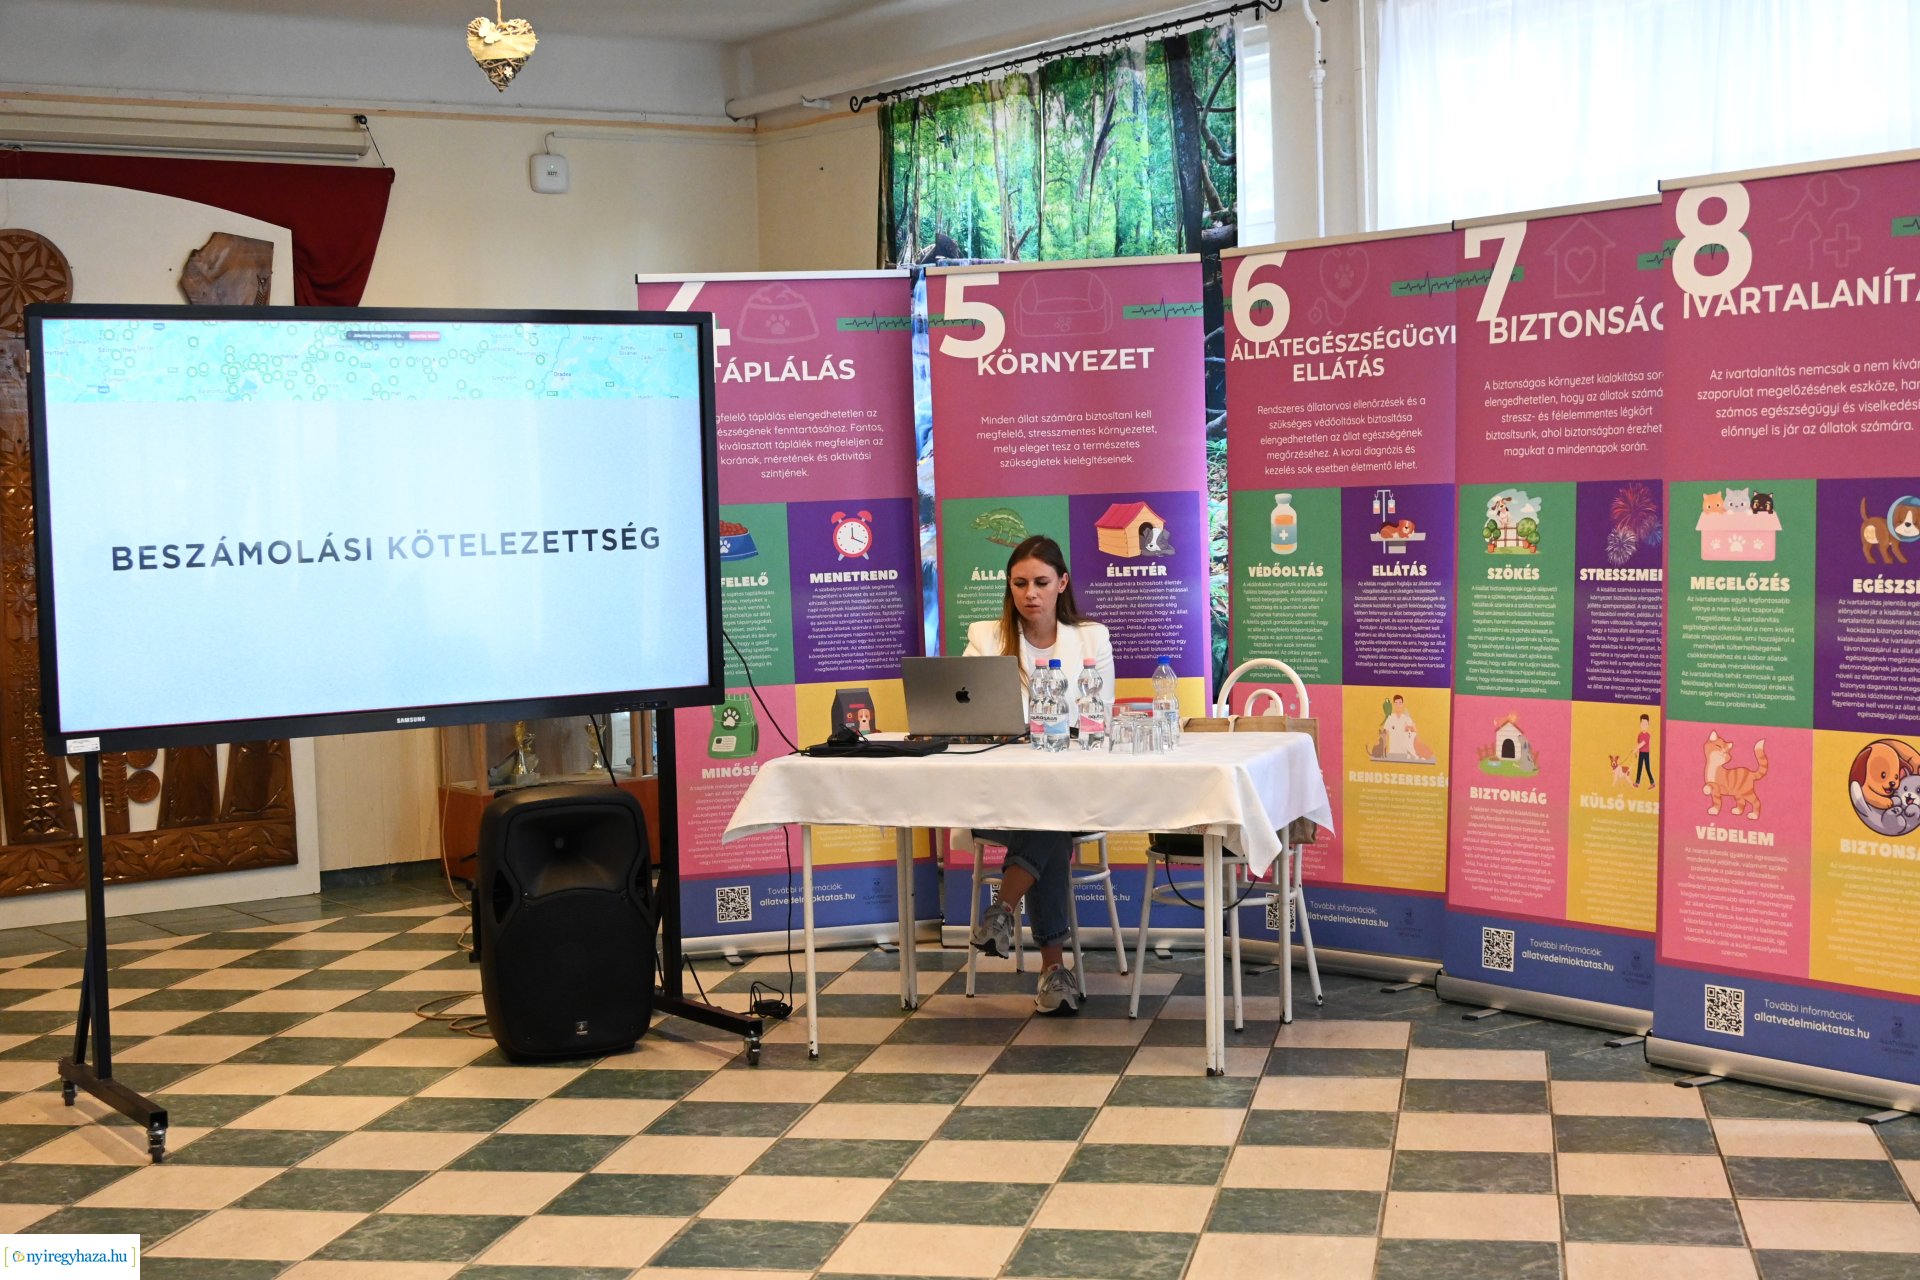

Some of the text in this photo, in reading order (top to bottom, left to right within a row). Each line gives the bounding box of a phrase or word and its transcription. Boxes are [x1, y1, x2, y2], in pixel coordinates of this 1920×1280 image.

[1672, 182, 1752, 297] 8
[1464, 220, 1527, 322] 7
[1231, 251, 1291, 344] 6
[1683, 267, 1920, 320] IVARTALANÍT
[939, 272, 1006, 359] 5
[1230, 324, 1457, 361] ÁLLATEGÉSZSÉGÜGYI
[715, 354, 856, 383] ÁPLÁLÁS
[977, 347, 1155, 376] KÖRNYEZET
[1293, 355, 1385, 382] ELLÁTÁS
[1709, 369, 1723, 380] Az
[1725, 365, 1796, 379] ivartalanítás
[1798, 361, 1850, 375] nemcsak
[1852, 363, 1861, 373] a
[1863, 361, 1889, 372] nem
[1484, 371, 1664, 390] A biztonságos környezet kialakítása sor
[1484, 393, 1558, 408] elengedhetetlen,
[1560, 392, 1584, 405] hogy
[1586, 393, 1597, 402] az
[1599, 388, 1629, 401] állatok
[1697, 386, 1754, 402] szaporulat
[1756, 381, 1847, 399] megelőzésének
[1849, 379, 1898, 393] eszköze,
[1257, 396, 1426, 415] Rendszeres állatorvosi ellenőrzések és a
[1501, 405, 1653, 423] stressz- és félelemmentes légkört
[1715, 406, 1758, 418] számos
[1760, 402, 1840, 419] egészségügyi
[1842, 401, 1855, 413] és
[748, 411, 786, 423] táplálás
[788, 409, 864, 421] elengedhetetlen
[980, 409, 1152, 424] Minden állat számára biztosítani kell
[1268, 412, 1413, 430] szükséges védőoltások biztosítása
[774, 423, 848, 435] fenntartásához.
[850, 423, 884, 432] Fontos,
[976, 424, 1157, 441] megfelelő, stresszmentes környezetet,
[1260, 427, 1422, 446] elengedhetetlen az állat egészségének
[1485, 428, 1539, 441] biztosítsunk,
[1540, 427, 1562, 438] ahol
[1564, 424, 1625, 438] biztonságban
[1720, 419, 1914, 439] előnnyel is jár az állatok számára.
[719, 437, 883, 451] kiválasztott táplálék megfeleljen az
[993, 440, 1140, 455] mely eleget tesz a természetes
[1266, 444, 1415, 461] megőrzéséhez. A korai diagnózis és
[1503, 441, 1648, 458] magukat a mindennapok során.
[720, 451, 871, 465] korának, méretének és aktivitási
[999, 453, 1134, 468] szükségletek kielégítéseinek.
[1264, 459, 1417, 475] kezelés sok esetben életmentő lehet.
[760, 467, 809, 479] szintjének.
[112, 523, 662, 572] BESZÁMOLÁSI KÖTELEZETTSÉG
[809, 570, 899, 584] MENETREND
[1106, 561, 1168, 577] ÉLETTÉR
[1248, 562, 1324, 578] VÉDŐOLTÁS
[1372, 561, 1428, 577] ELLÁTÁS
[1487, 564, 1540, 580] SZÖKÉS
[1690, 572, 1790, 592] MEGELŐZÉS
[396, 716, 426, 724] SAMSUNG
[1470, 786, 1547, 805] BIZTONSÁG
[1580, 793, 1660, 814] KÜLSŐ VESZ
[1696, 822, 1774, 847] VÉDELEM
[1306, 912, 1389, 928] llatvedelmioktatas.hu
[1522, 950, 1615, 972] allatvedelmioktatas.hu
[1763, 998, 1854, 1022] További információk:
[1754, 1011, 1870, 1040] allatvedelmioktatas.hu
